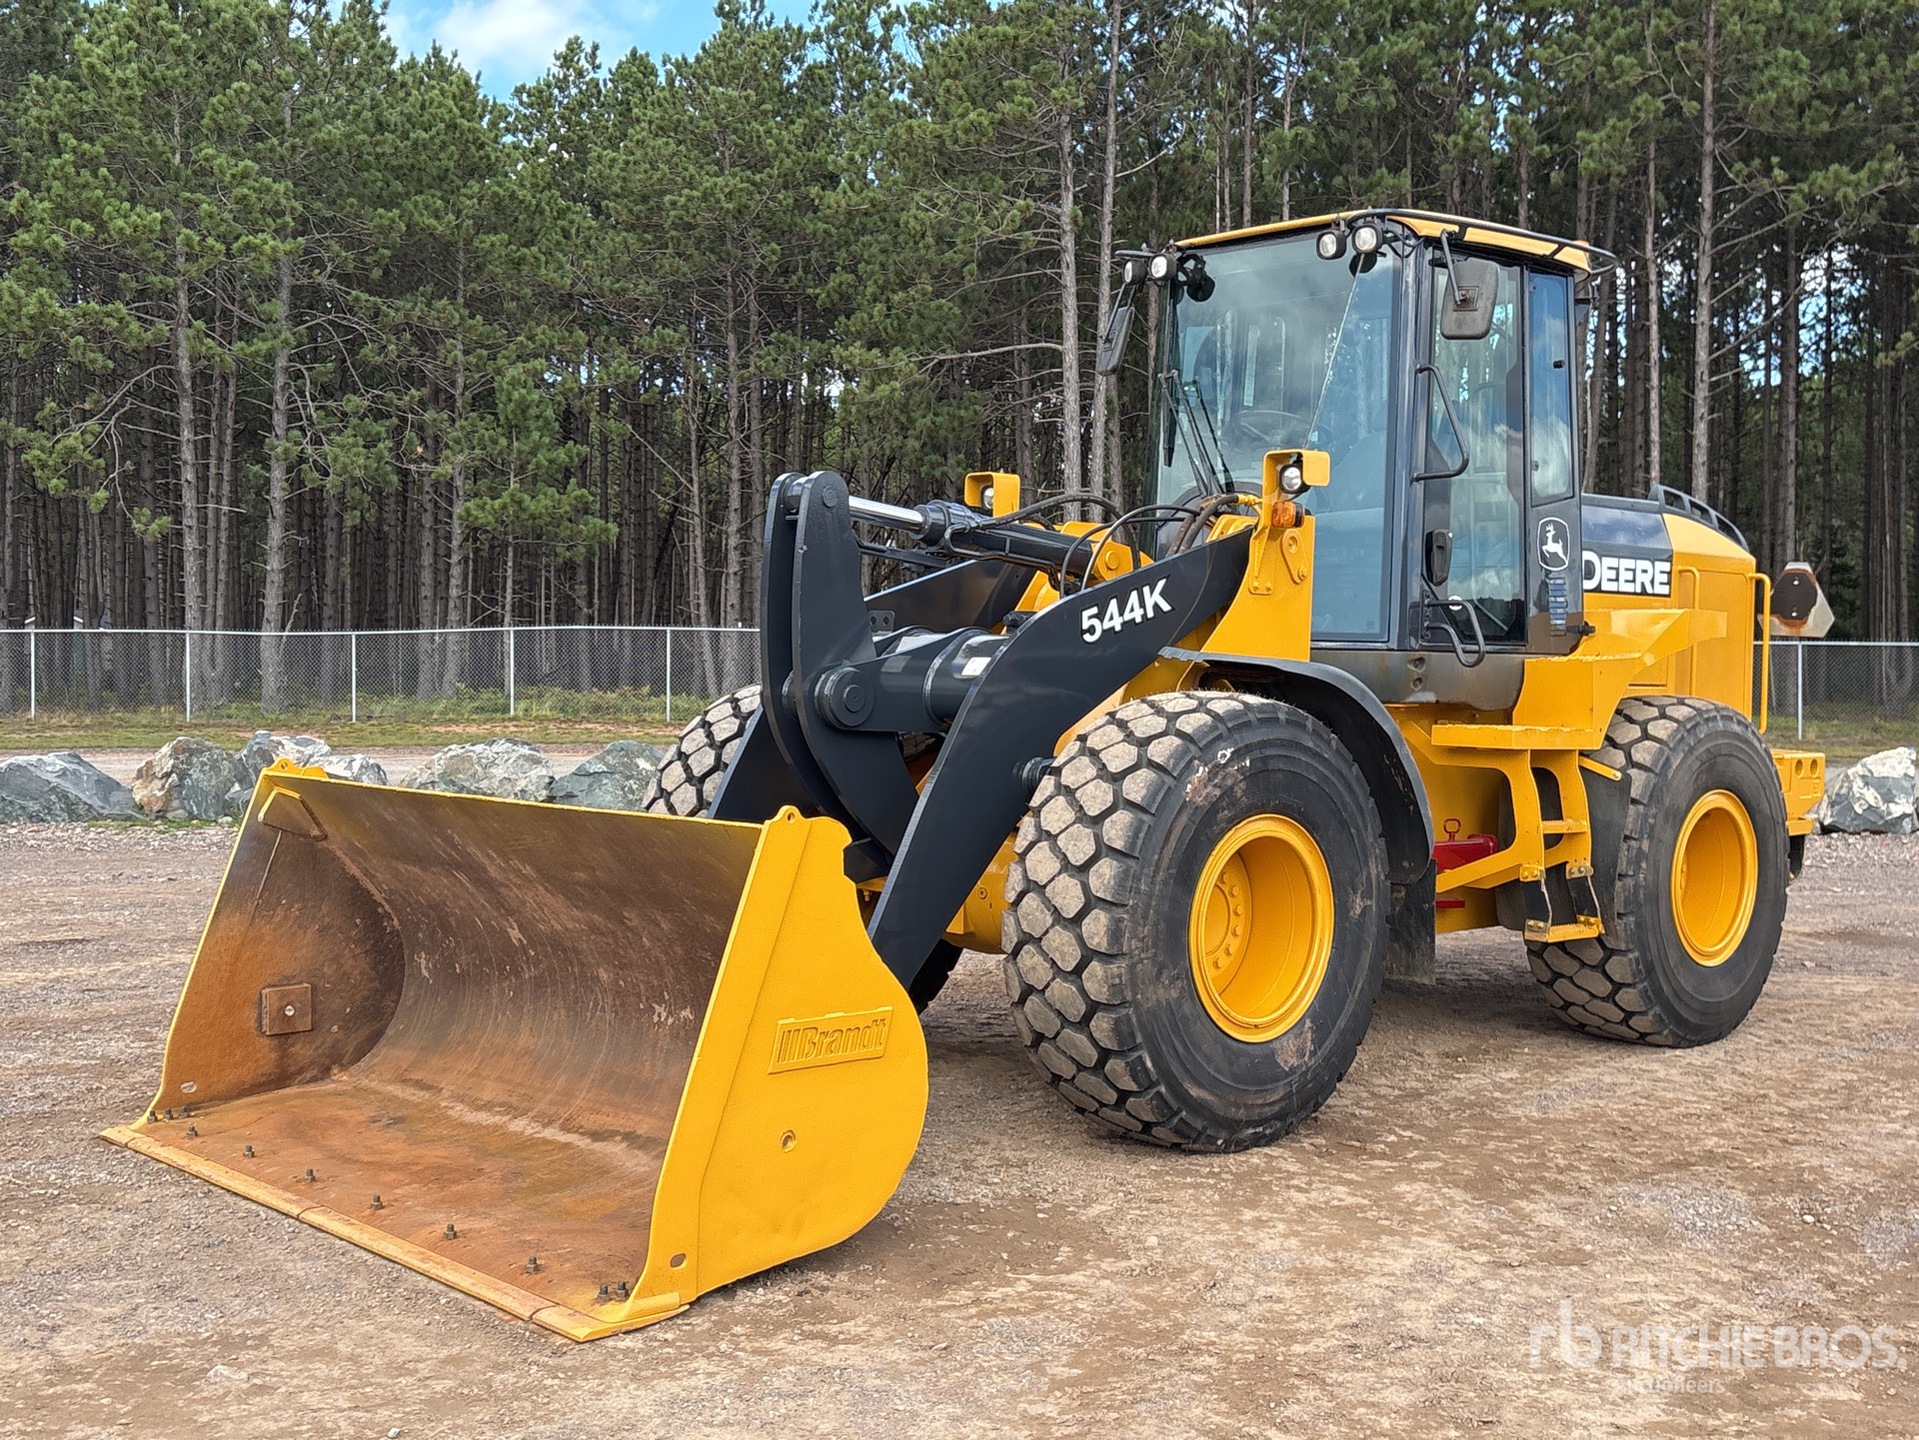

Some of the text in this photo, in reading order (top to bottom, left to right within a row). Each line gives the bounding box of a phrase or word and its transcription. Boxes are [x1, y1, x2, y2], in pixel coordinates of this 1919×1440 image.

[1582, 550, 1671, 596] DEERE
[1081, 578, 1172, 643] 544K
[796, 1018, 887, 1061] Brandt
